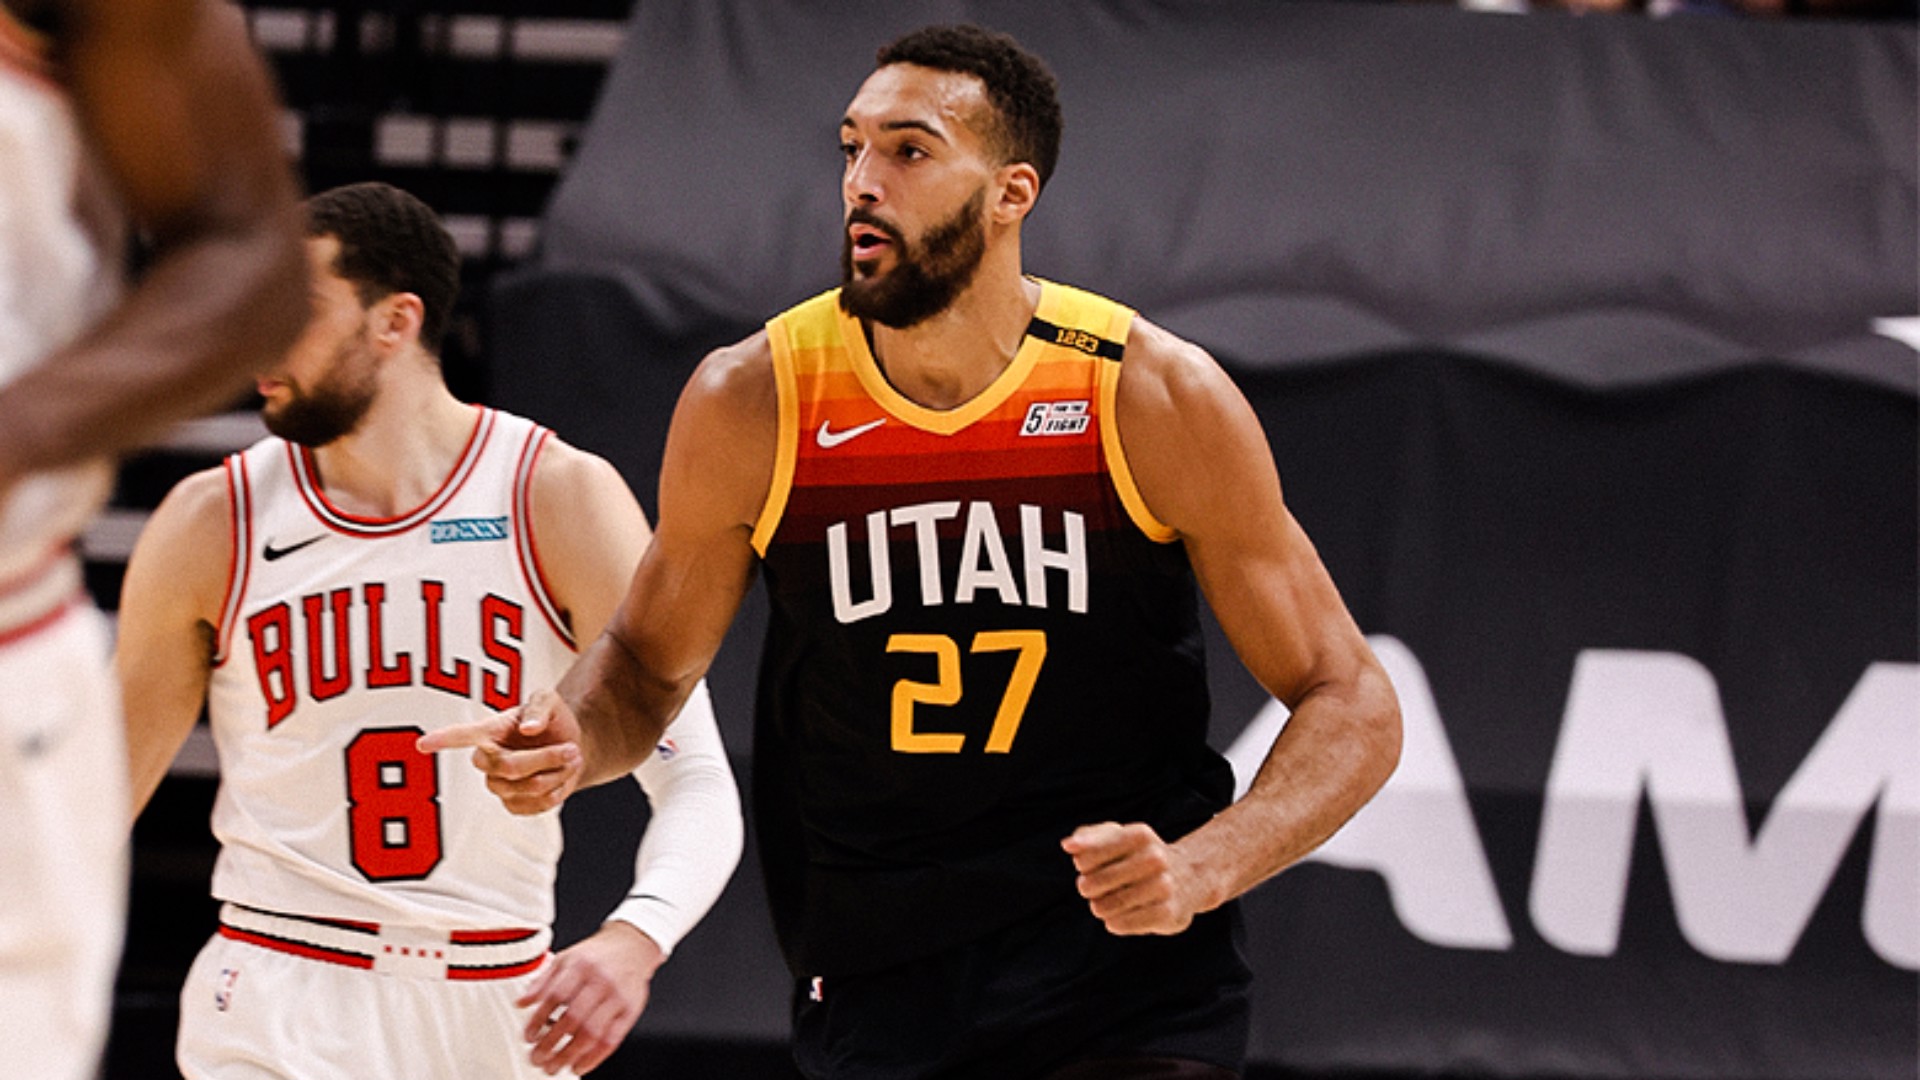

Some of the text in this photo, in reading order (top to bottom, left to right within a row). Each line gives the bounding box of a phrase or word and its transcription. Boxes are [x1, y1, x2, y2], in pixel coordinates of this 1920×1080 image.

[1025, 404, 1047, 434] 5
[827, 501, 1088, 624] UTAH
[246, 579, 524, 731] BULLS
[885, 629, 1048, 754] 27
[344, 725, 443, 884] 8
